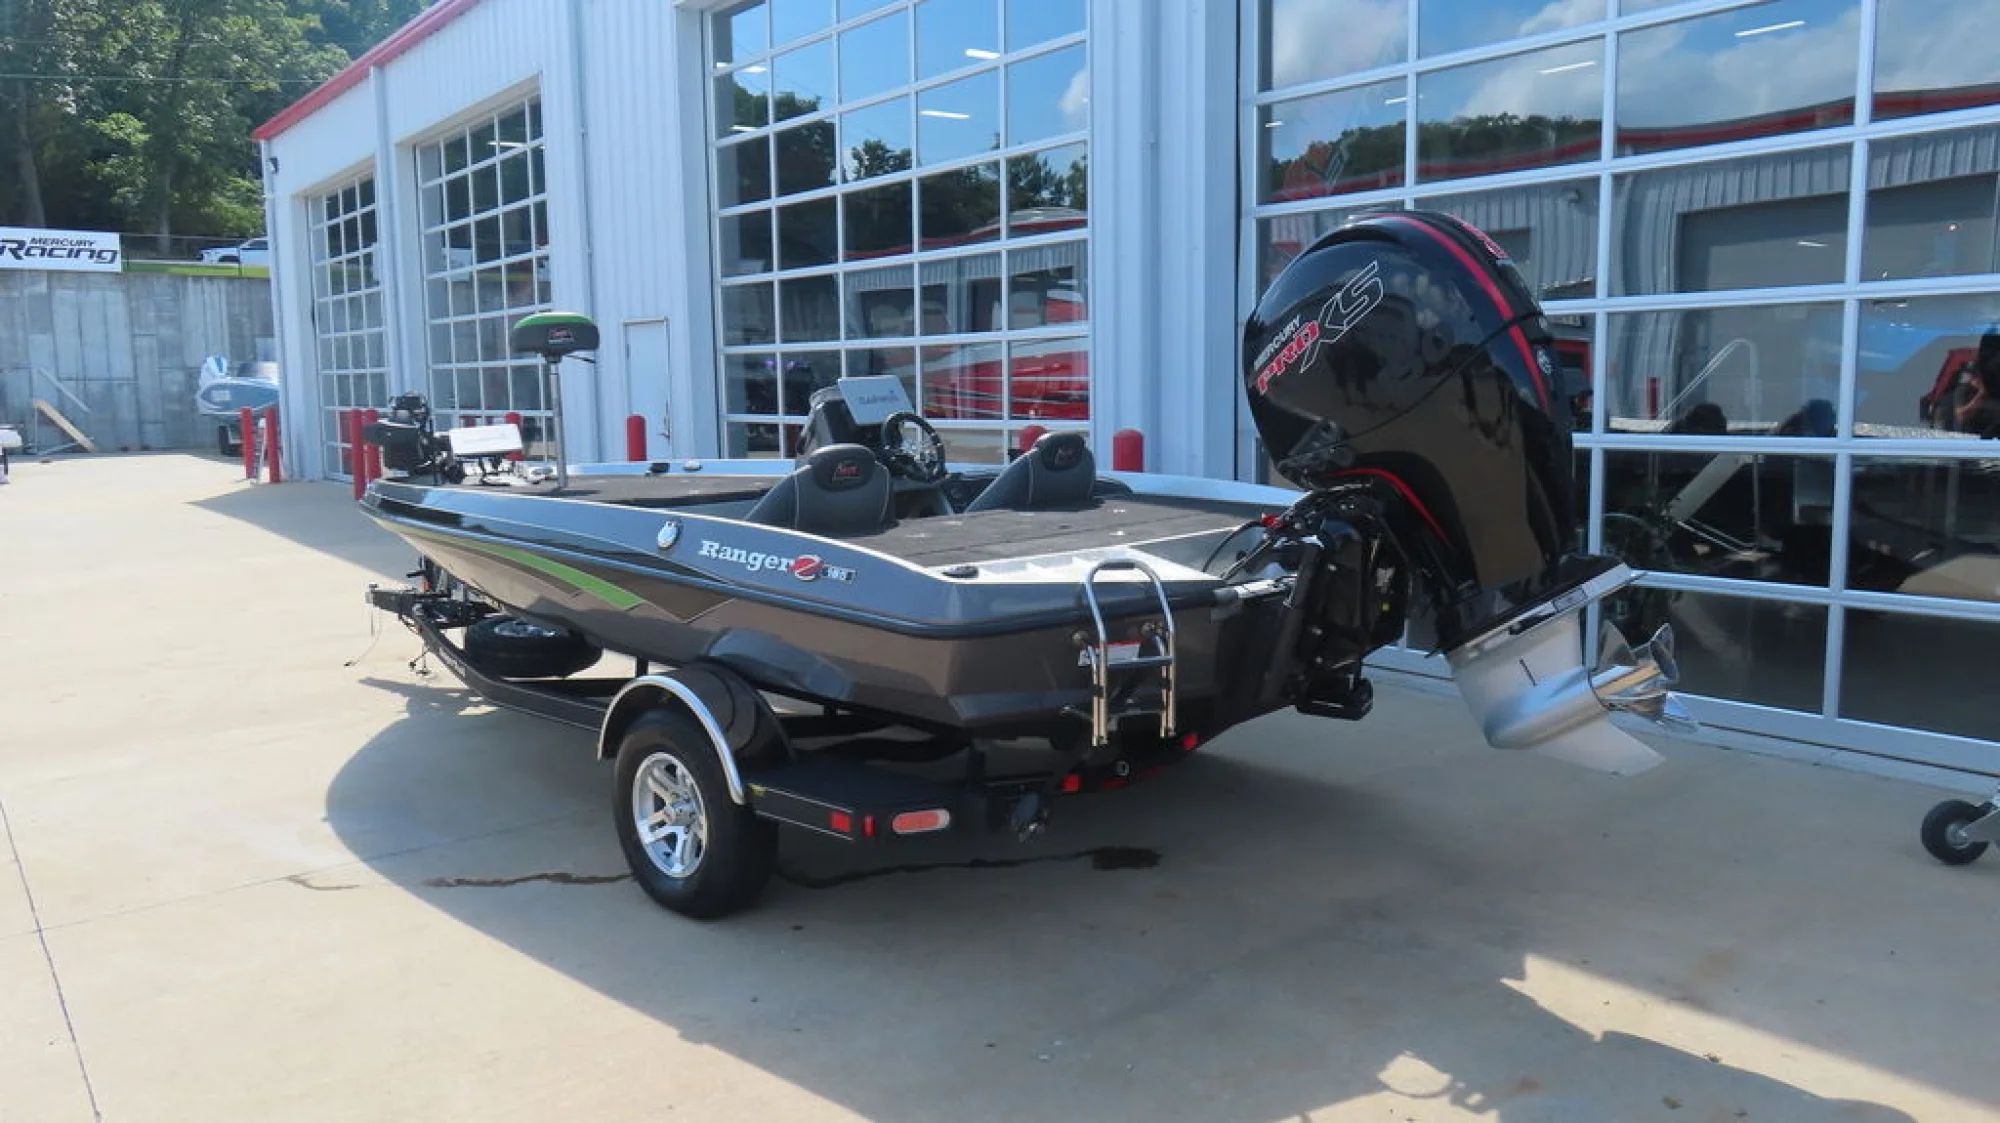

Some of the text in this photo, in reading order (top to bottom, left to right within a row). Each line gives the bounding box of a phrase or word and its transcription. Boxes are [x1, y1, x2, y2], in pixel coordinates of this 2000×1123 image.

[0, 239, 118, 264] Racing
[30, 237, 95, 247] MERCURY
[1258, 260, 1384, 395] PRO XS
[698, 540, 794, 571] Ranger
